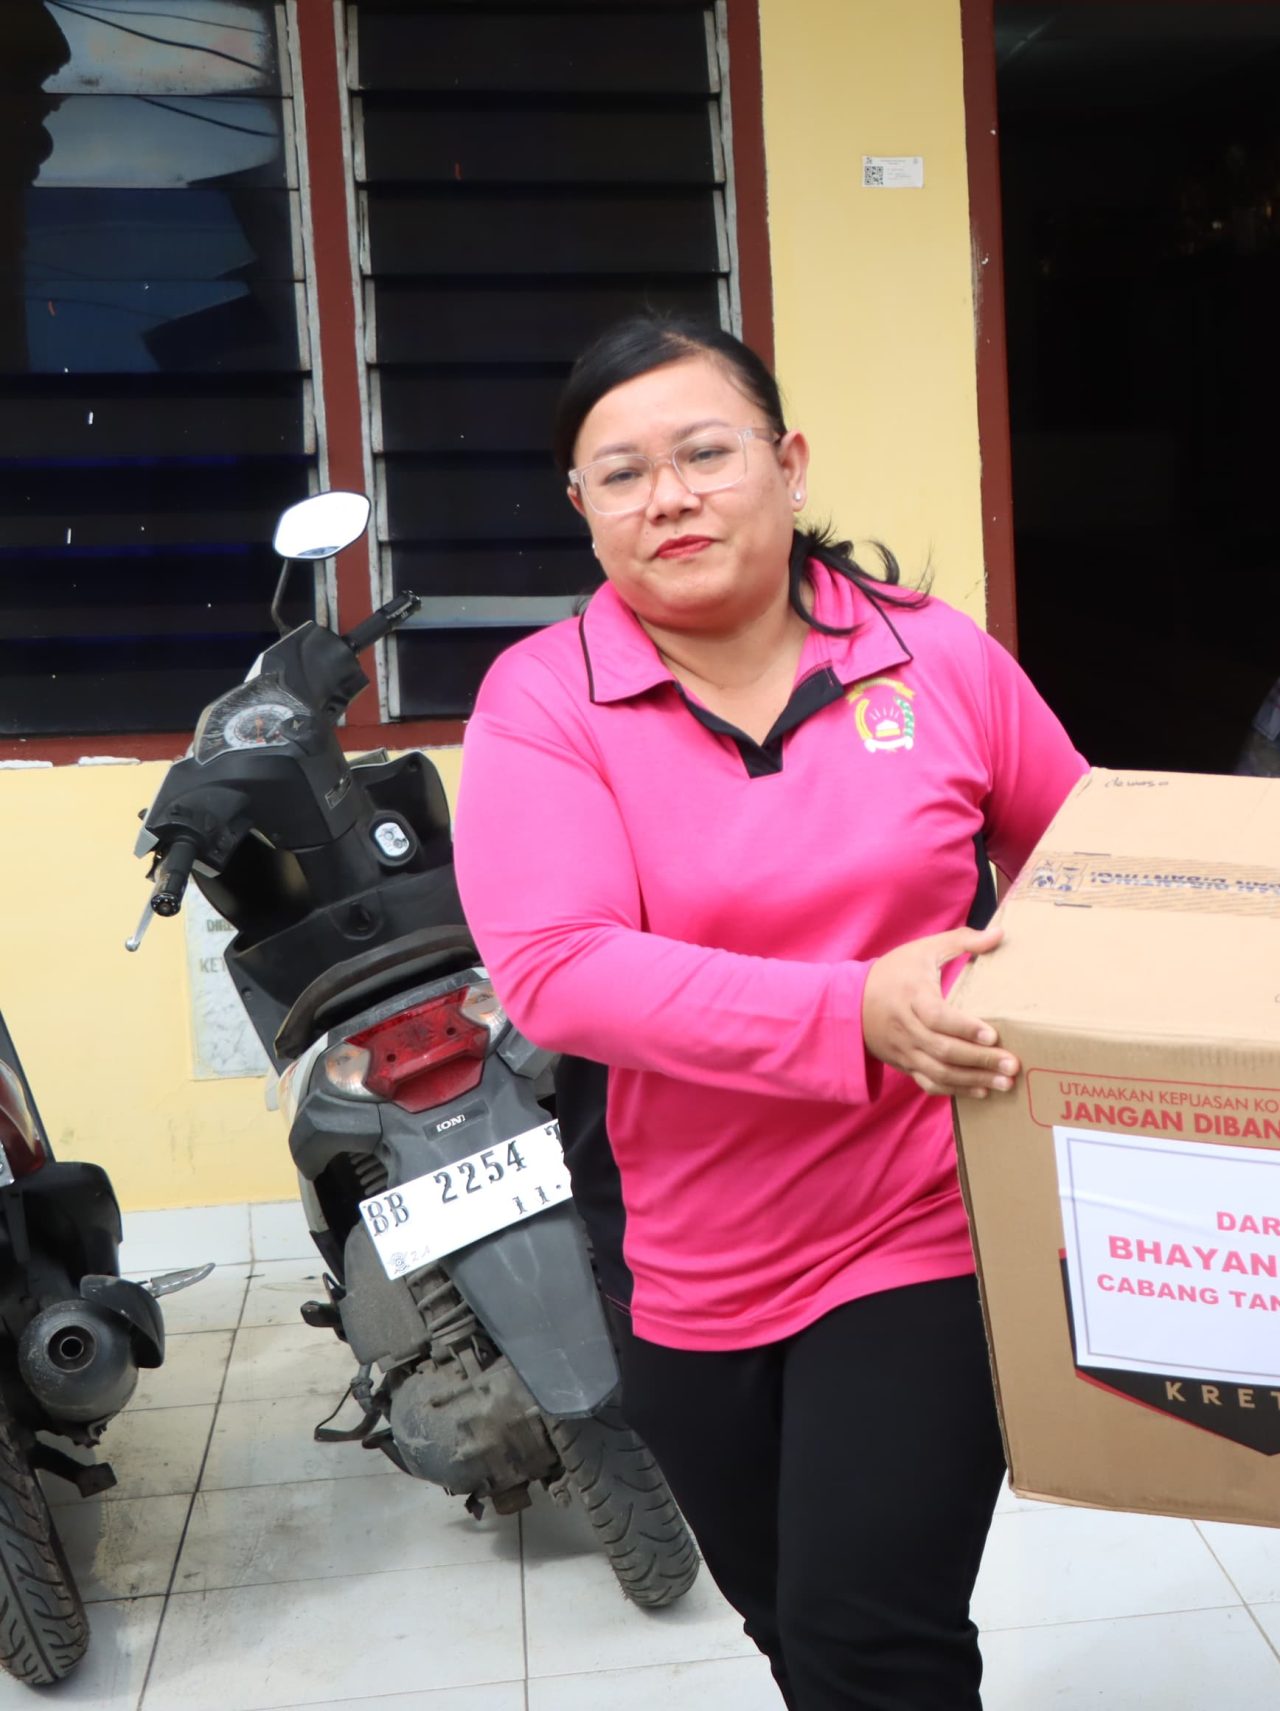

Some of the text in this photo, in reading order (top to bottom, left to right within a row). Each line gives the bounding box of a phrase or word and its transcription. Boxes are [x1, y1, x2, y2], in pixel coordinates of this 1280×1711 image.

[1059, 1081, 1155, 1103] UTAMAKAN
[1158, 1091, 1249, 1111] KEPUASAN
[1060, 1101, 1184, 1132] JANGAN
[433, 1140, 529, 1204] 2254
[1097, 1274, 1220, 1306] CABANG
